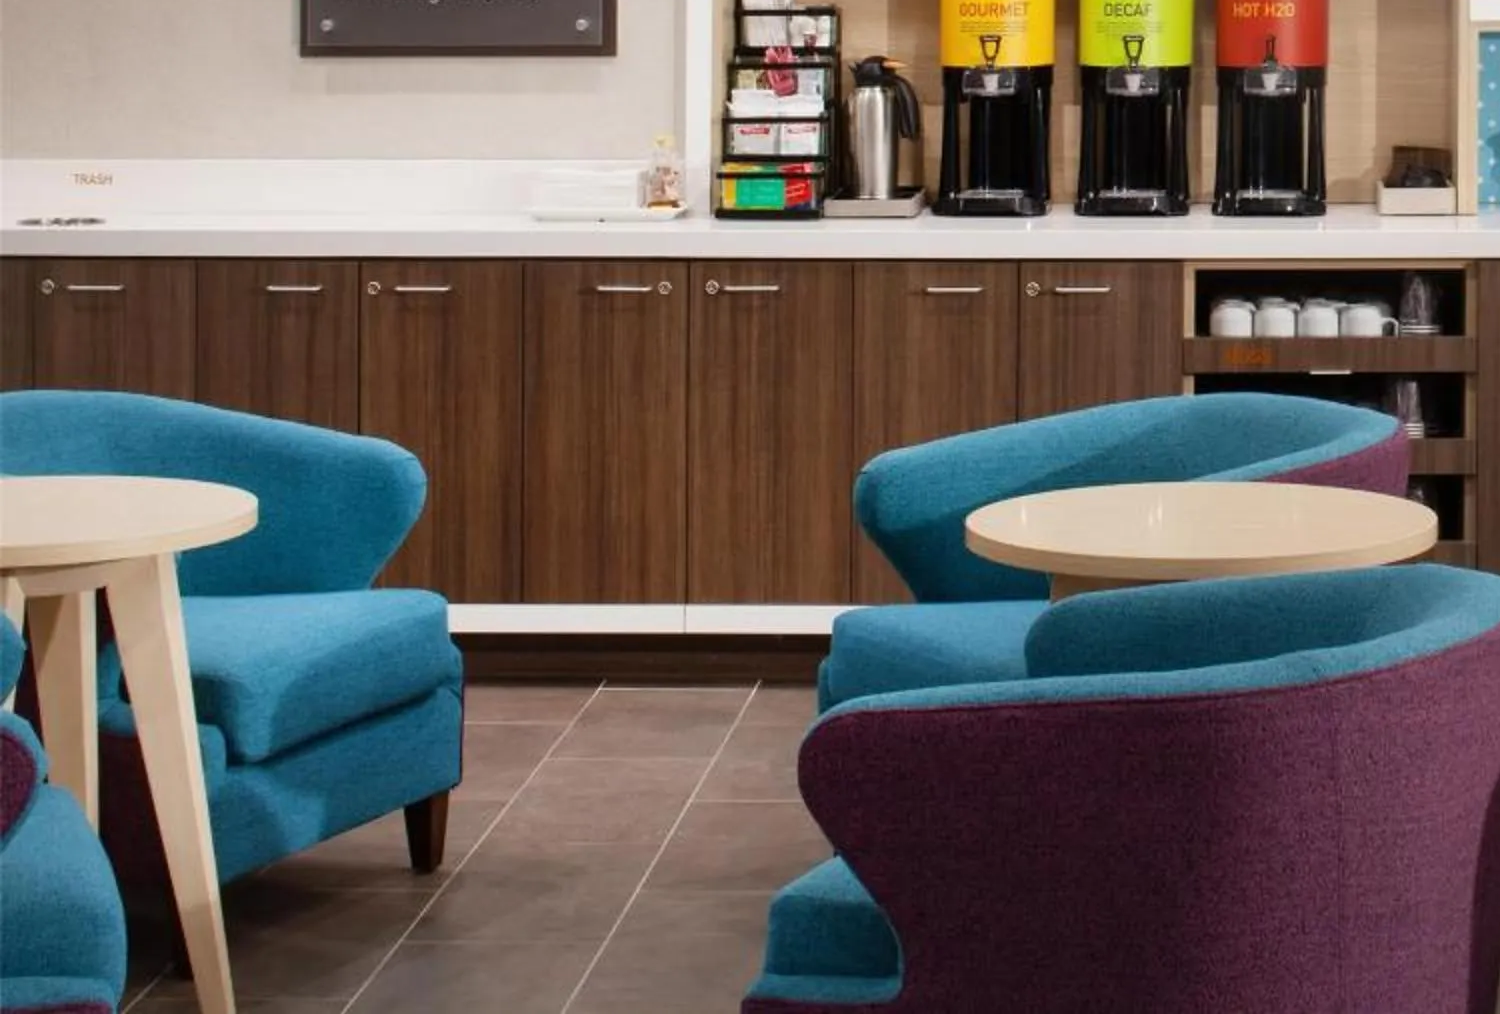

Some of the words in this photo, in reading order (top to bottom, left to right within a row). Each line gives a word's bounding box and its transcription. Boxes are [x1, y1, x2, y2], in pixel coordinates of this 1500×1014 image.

[959, 1, 1030, 18] GOURMET
[1104, 3, 1152, 17] DECAF
[1233, 3, 1260, 17] HOT
[73, 172, 114, 185] TRASH
